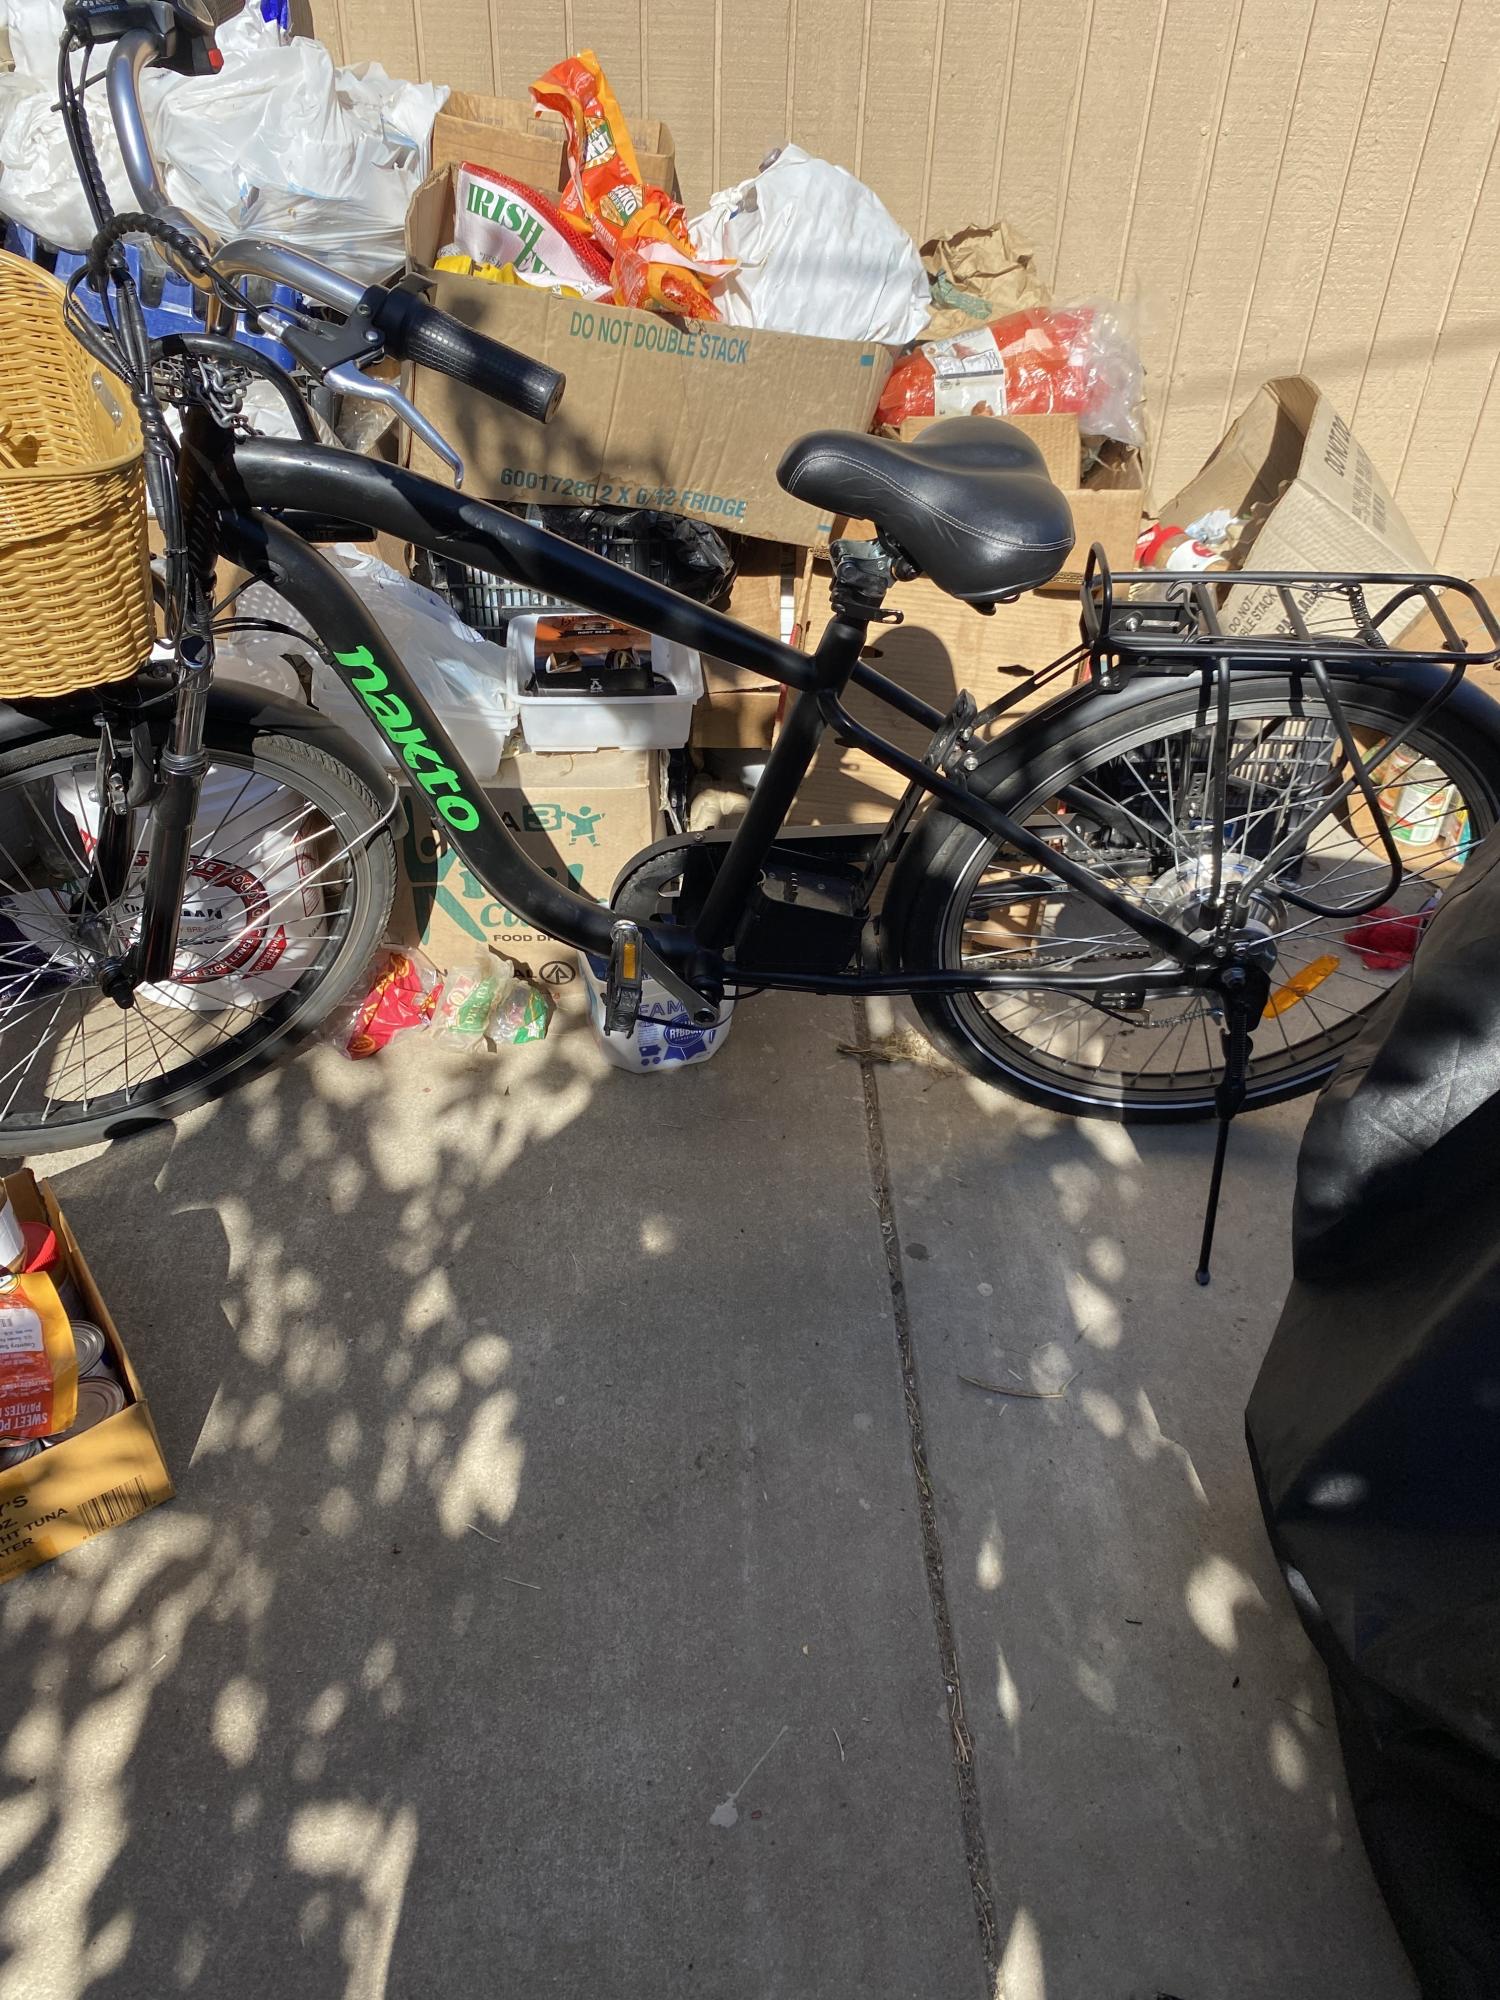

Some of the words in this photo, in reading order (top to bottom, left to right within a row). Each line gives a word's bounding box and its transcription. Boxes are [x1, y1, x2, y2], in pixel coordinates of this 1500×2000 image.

[466, 183, 545, 245] IRISH
[569, 311, 595, 339] DO
[599, 316, 633, 346] NOT
[633, 323, 697, 356] DOUBLE
[700, 333, 750, 364] STACK
[601, 485, 612, 501] 2
[619, 487, 630, 504] X
[636, 489, 677, 506] 6/12
[680, 491, 747, 518] FRIDGE
[1228, 616, 1241, 633] DO
[1238, 596, 1255, 617] NOT
[1239, 616, 1257, 636] BLE
[1250, 589, 1278, 623] STACK
[333, 645, 480, 831] nakto
[266, 948, 282, 965] PACK
[5, 1402, 42, 1417] PATATES
[14, 1412, 48, 1428] SWEET
[24, 1507, 68, 1532] TUNA
